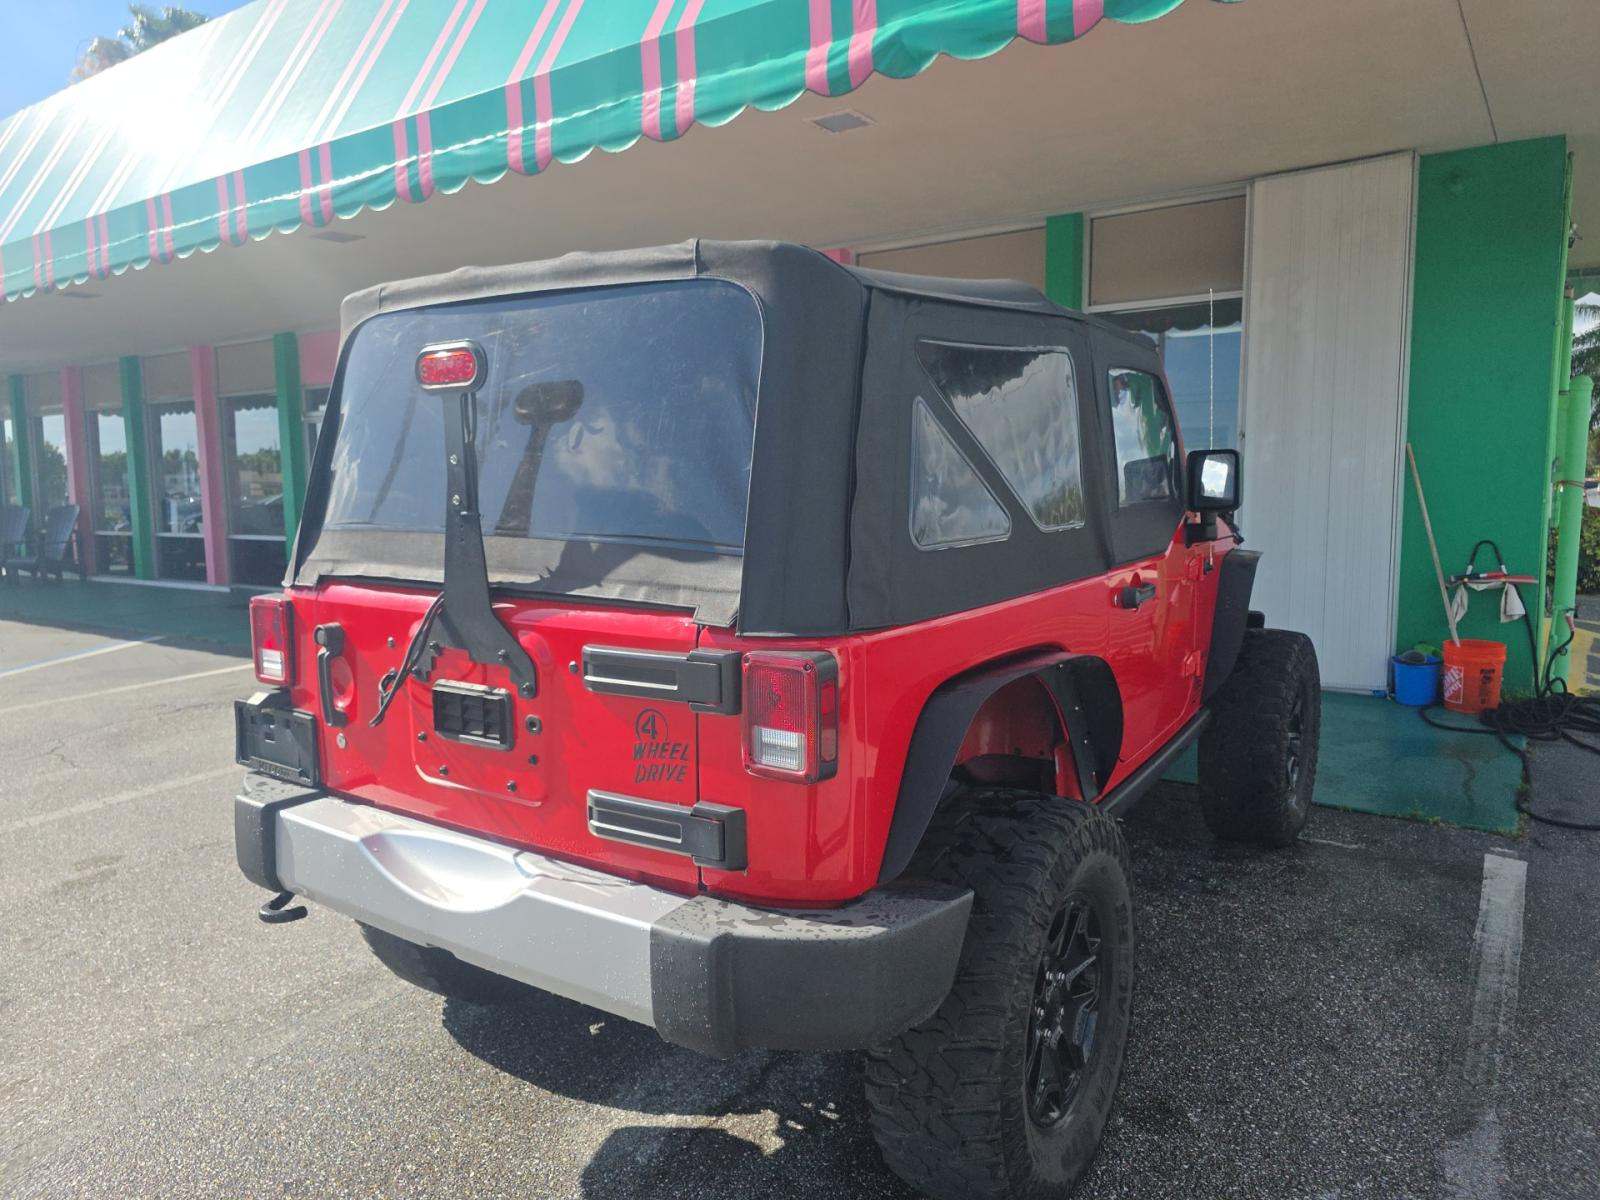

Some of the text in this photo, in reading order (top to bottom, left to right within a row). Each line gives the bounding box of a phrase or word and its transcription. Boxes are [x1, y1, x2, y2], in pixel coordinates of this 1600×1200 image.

[641, 714, 657, 740] 4
[633, 742, 689, 761] WHEEL
[634, 763, 688, 784] DRIVE
